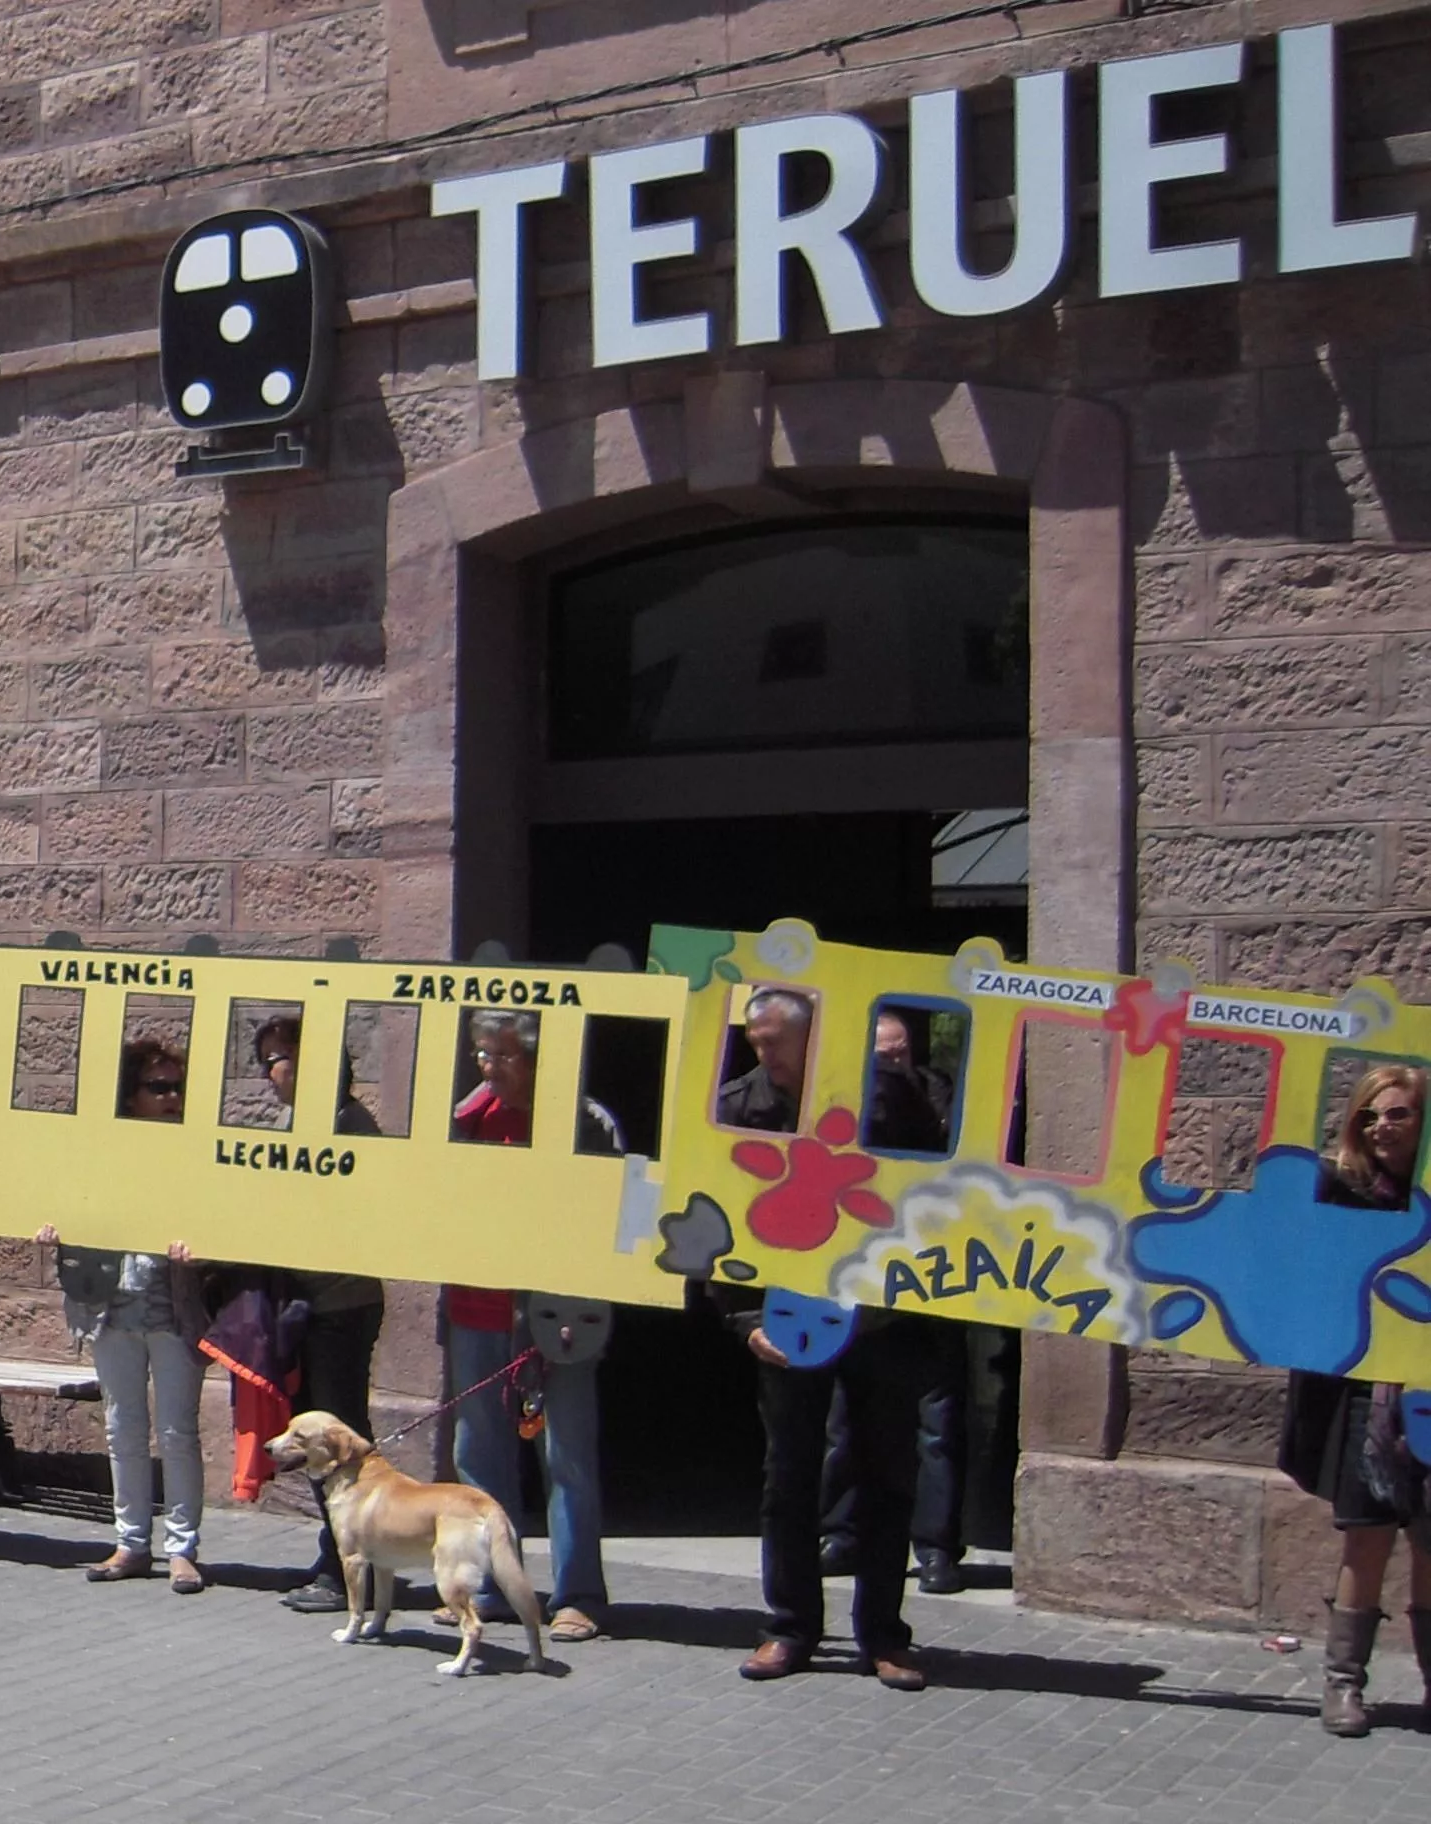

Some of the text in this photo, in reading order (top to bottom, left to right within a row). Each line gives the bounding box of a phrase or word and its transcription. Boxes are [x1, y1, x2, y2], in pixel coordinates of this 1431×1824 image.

[431, 22, 1417, 382] TERUEL
[394, 974, 581, 1007] ZARAGOZA
[976, 973, 1105, 1006] ZARAGOZA
[1193, 1002, 1343, 1034] BARCELONA
[216, 1139, 355, 1177] LECHAGO
